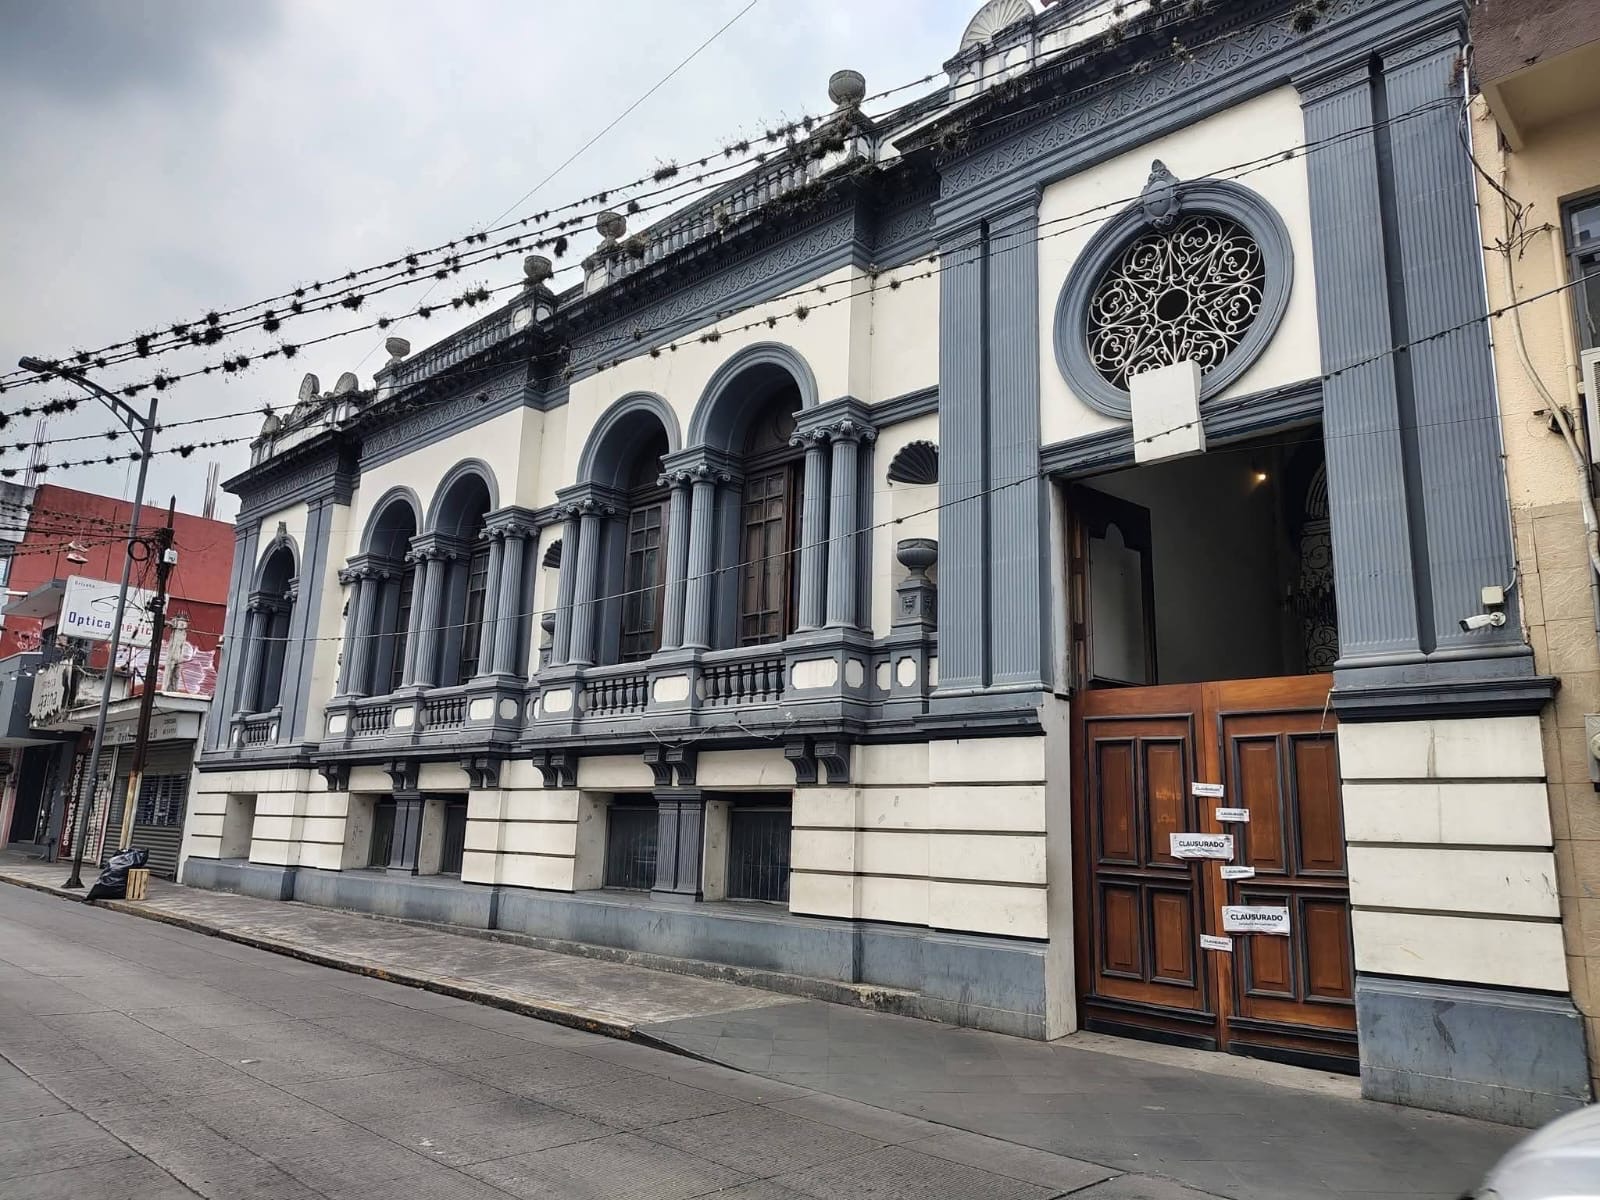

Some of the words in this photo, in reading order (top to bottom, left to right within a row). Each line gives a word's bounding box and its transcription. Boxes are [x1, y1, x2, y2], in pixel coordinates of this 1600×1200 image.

[68, 611, 111, 629] Optica
[1178, 840, 1225, 848] CLAUSURADO
[1230, 913, 1283, 922] CLAUSURADO
